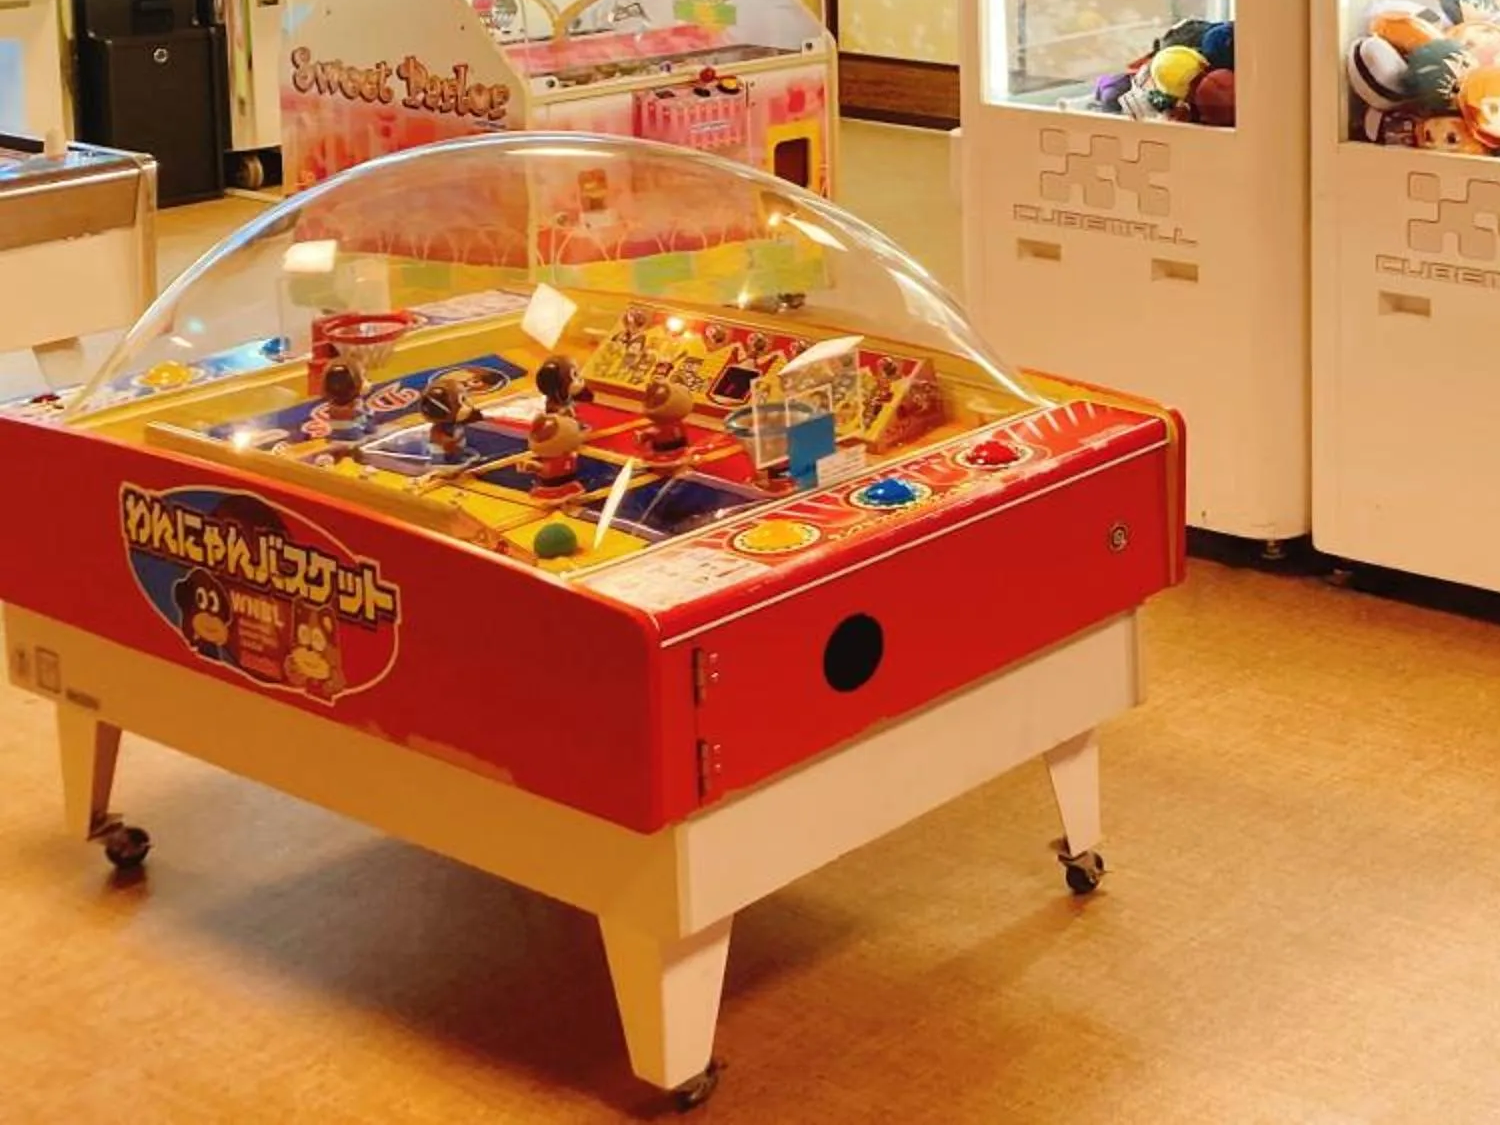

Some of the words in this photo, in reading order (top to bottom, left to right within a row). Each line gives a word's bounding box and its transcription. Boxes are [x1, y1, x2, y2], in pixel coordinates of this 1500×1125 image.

[290, 45, 394, 104] Sweet
[1012, 203, 1199, 245] CUBEMALL
[124, 493, 395, 621] わんにゃんバスケット
